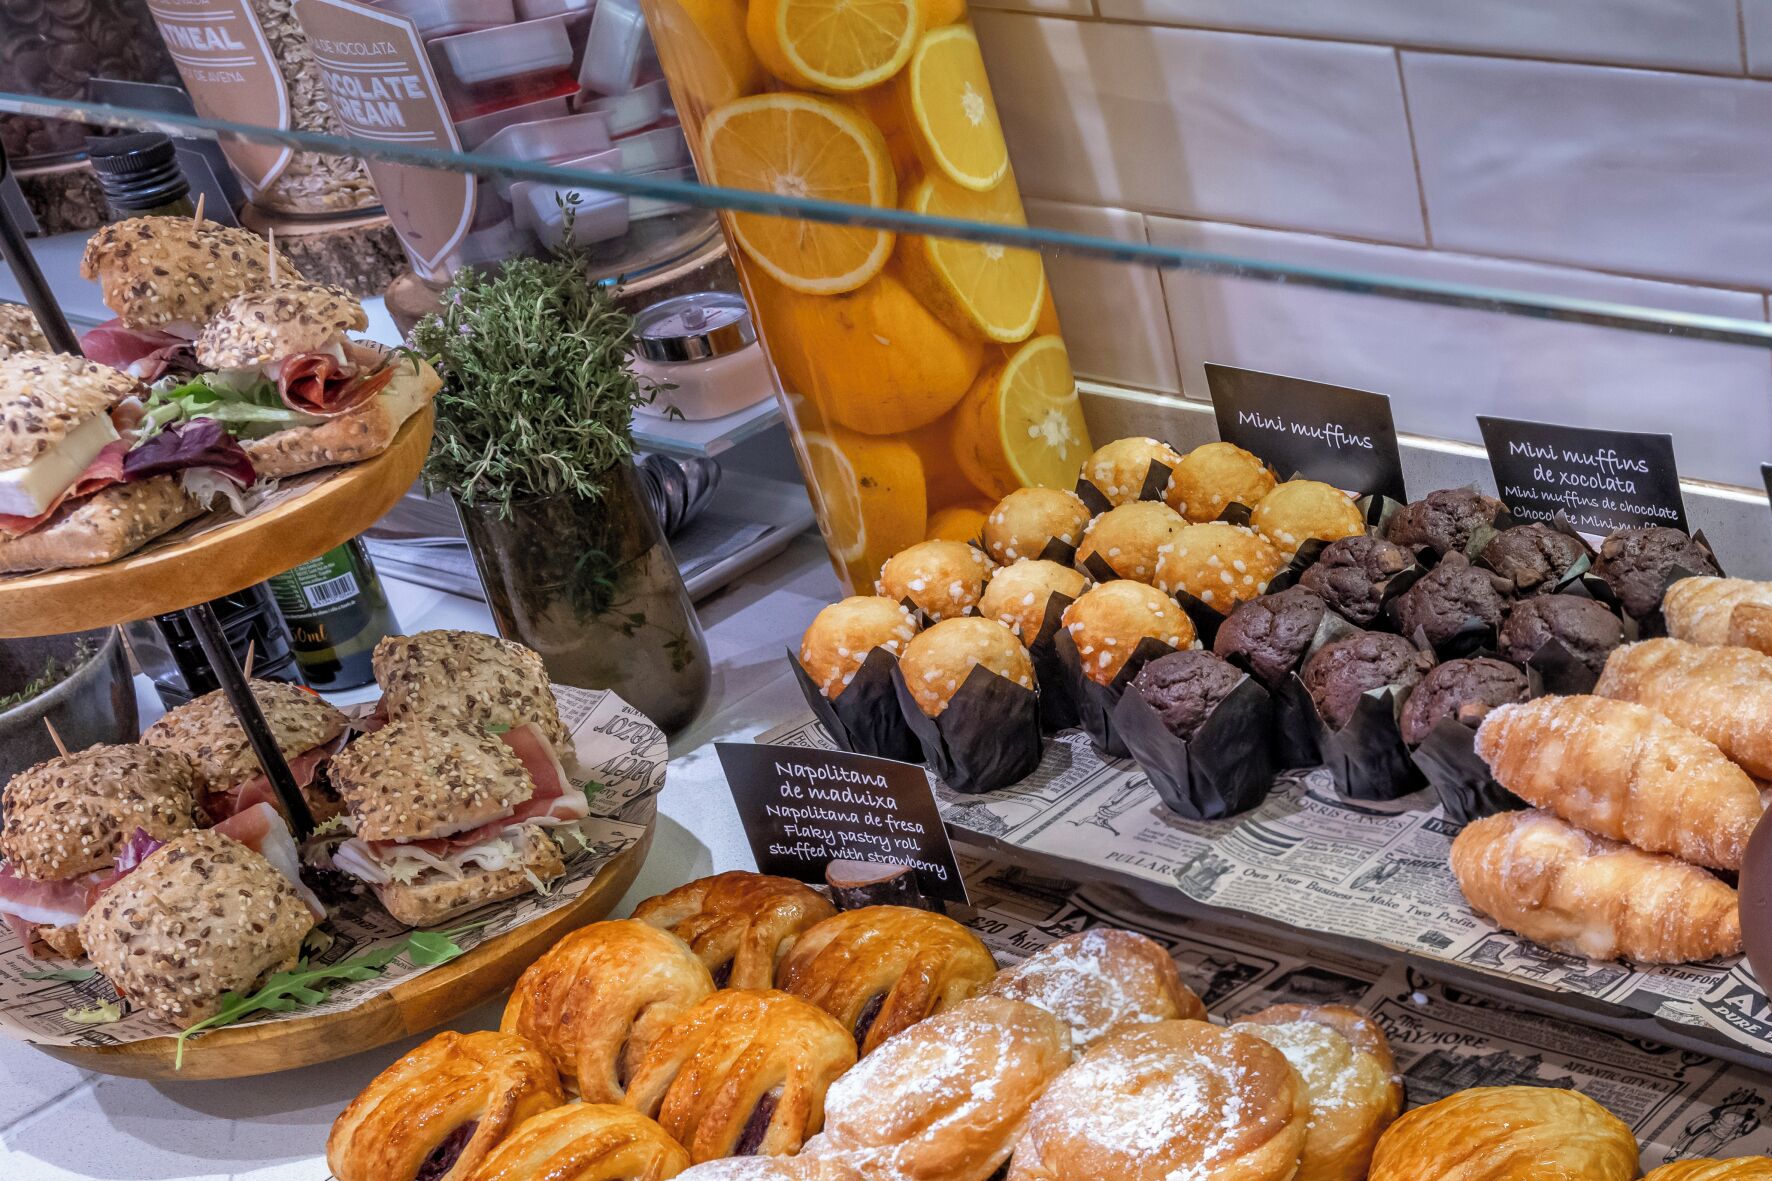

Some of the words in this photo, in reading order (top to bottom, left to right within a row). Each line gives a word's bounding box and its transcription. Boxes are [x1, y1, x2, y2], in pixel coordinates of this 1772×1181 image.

[1239, 410, 1286, 432] Mini
[1290, 422, 1374, 449] muffins
[1508, 441, 1558, 460] Mini
[1562, 448, 1649, 475] muffins
[1533, 464, 1555, 483] de
[1559, 472, 1637, 495] xocolata
[1505, 485, 1539, 500] Mini
[1541, 490, 1599, 509] muffins
[1602, 498, 1617, 511] de
[1619, 502, 1679, 521] chocolate
[775, 761, 889, 789] Napolitana
[780, 780, 804, 799] de
[808, 786, 898, 811] maduixa
[766, 804, 860, 824] Napolitana
[864, 811, 883, 828] de
[884, 814, 925, 835] fresa
[784, 824, 836, 846] Flaky
[838, 831, 891, 852] pastry
[893, 838, 922, 851] roll
[769, 842, 827, 861] stuffed
[829, 848, 864, 862] with
[867, 853, 948, 881] strawberry
[1274, 873, 1303, 887] Your
[1406, 904, 1432, 918] Two
[1437, 911, 1477, 929] Profits
[1713, 1005, 1765, 1035] PURE
